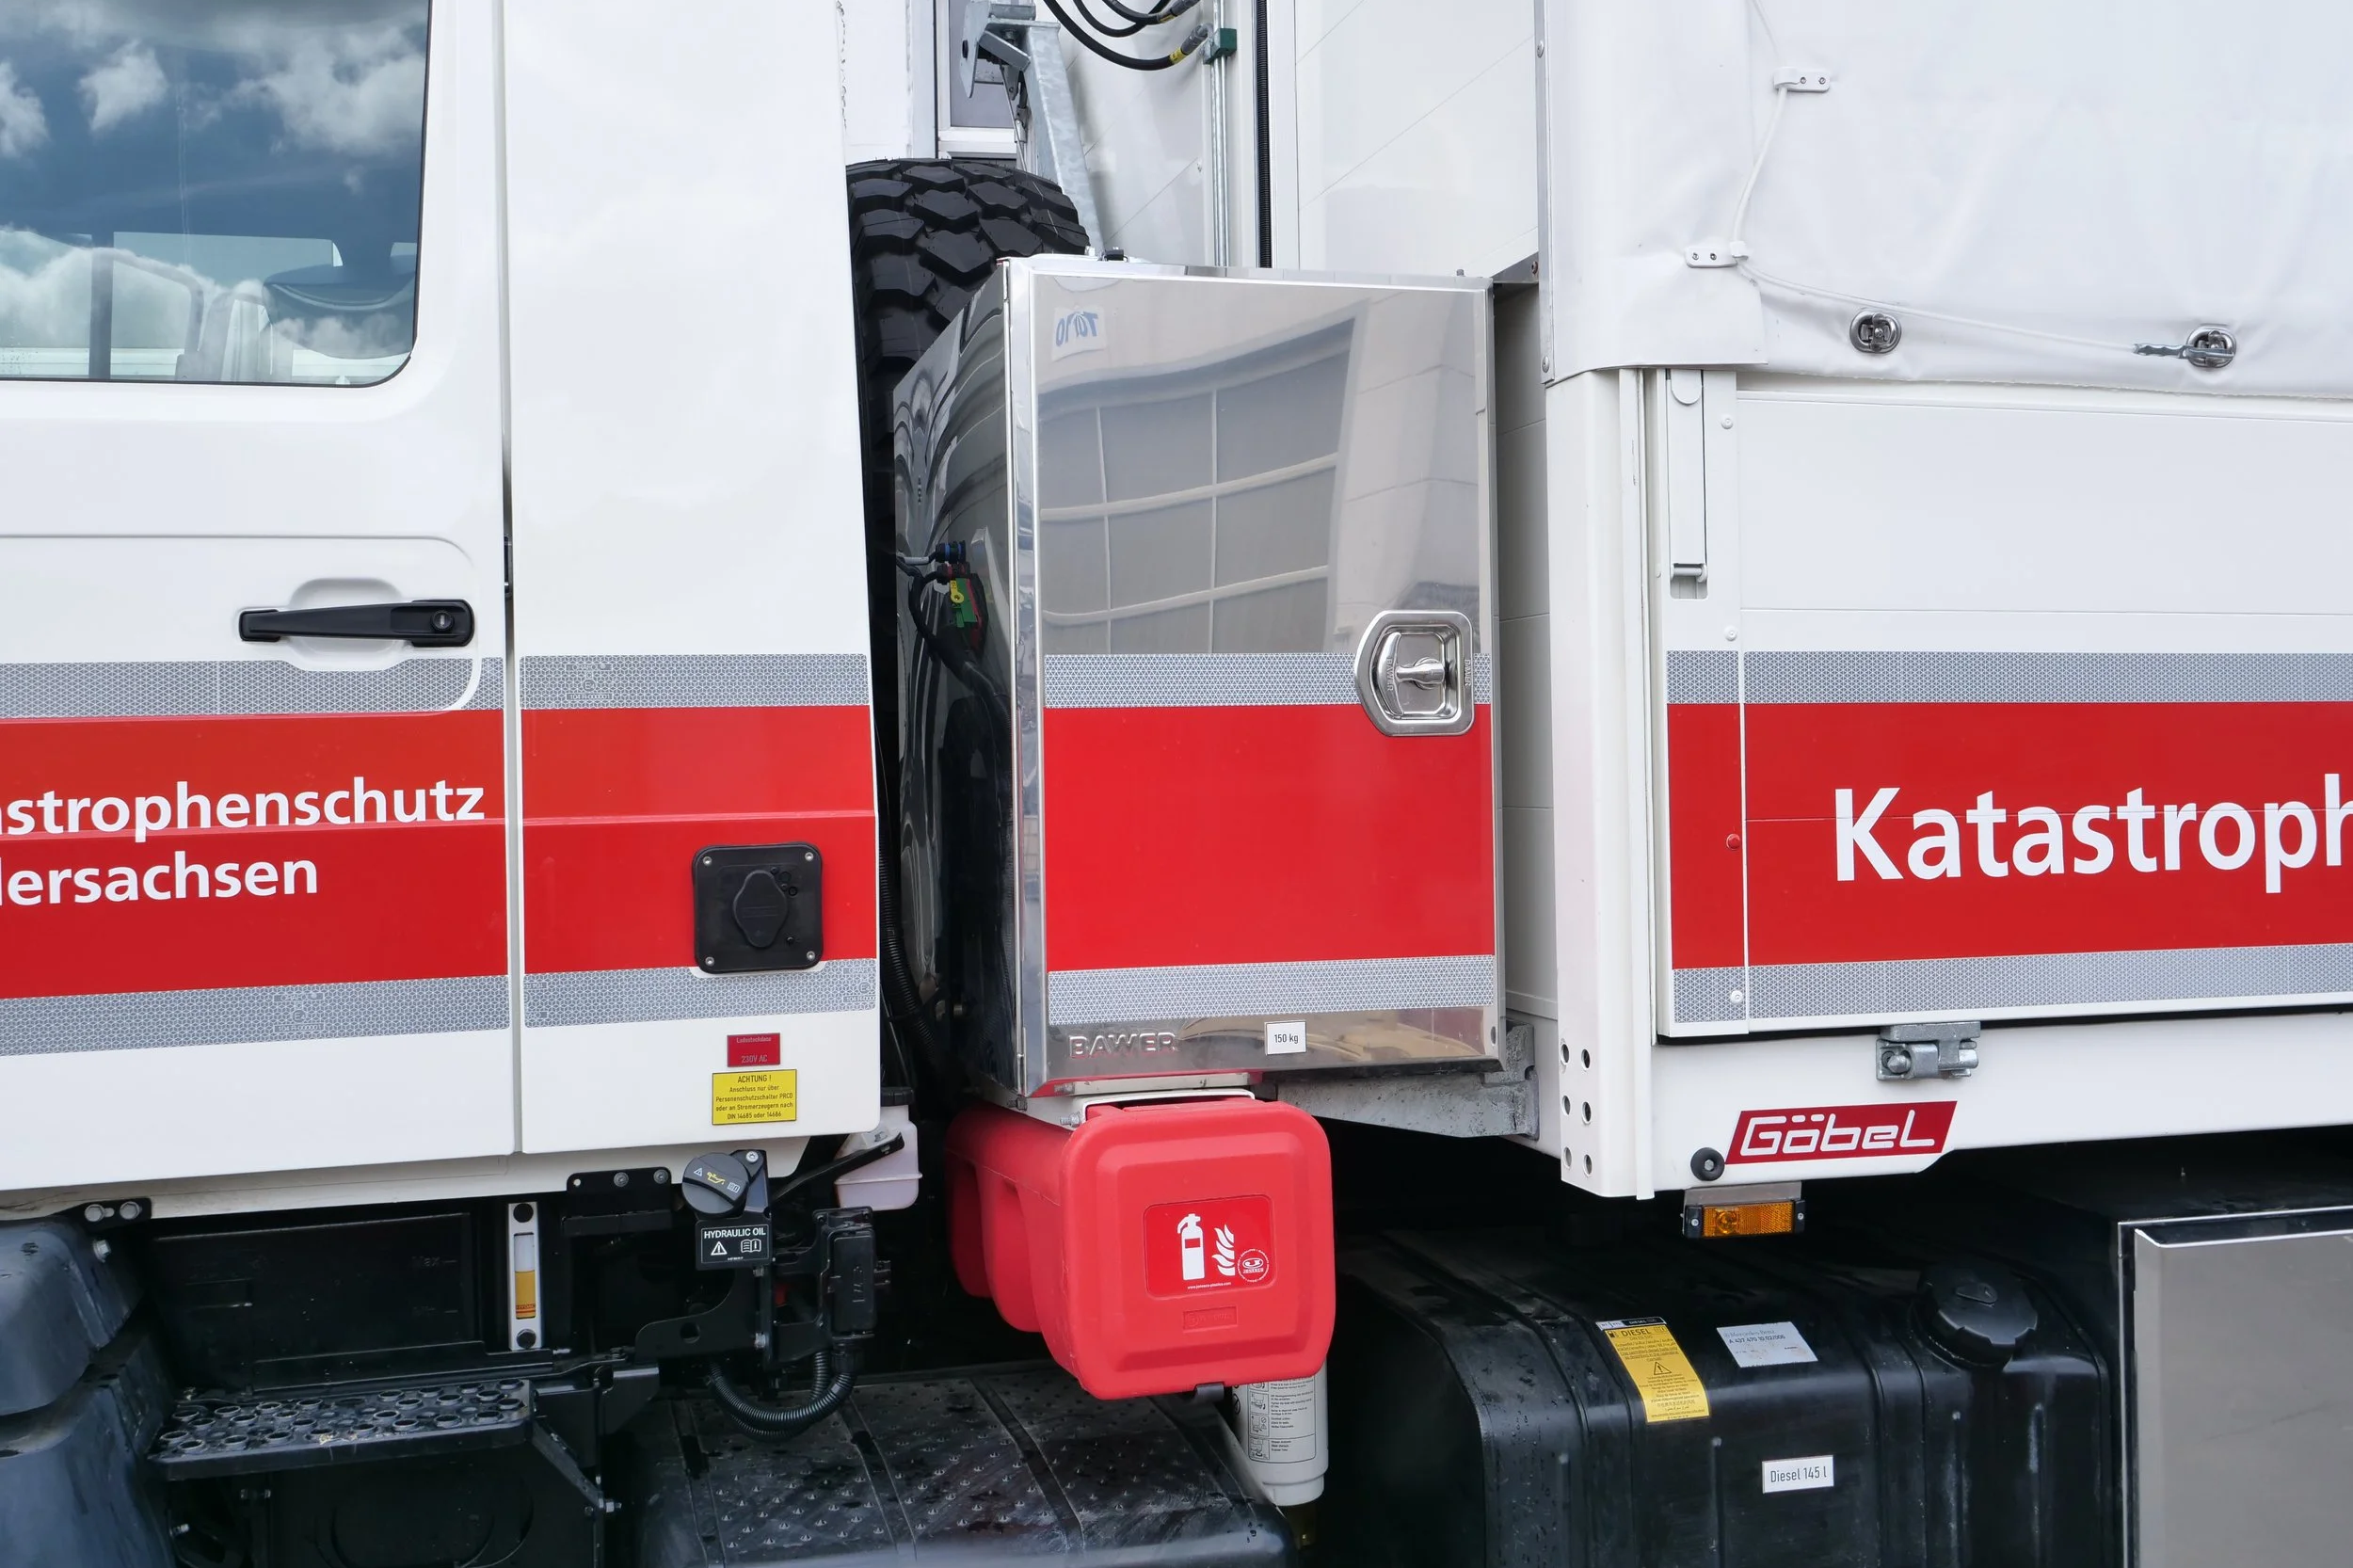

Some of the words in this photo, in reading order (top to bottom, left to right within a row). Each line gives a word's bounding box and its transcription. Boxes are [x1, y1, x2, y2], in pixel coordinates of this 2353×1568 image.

[0, 776, 485, 842] strophenschutz
[1835, 774, 2353, 893] Katastroph
[0, 851, 318, 906] ersachsen
[1273, 1033, 1288, 1044] 150
[1289, 1032, 1299, 1045] kg
[1069, 1032, 1176, 1058] BAWER
[741, 1054, 758, 1064] 230V
[759, 1054, 768, 1063] AC
[737, 1075, 768, 1083] ACHTUNG
[715, 1094, 778, 1102] Personenschutzschalter
[737, 1103, 779, 1112] Stromerzeugern
[704, 1228, 751, 1239] HYDRAULIC
[752, 1227, 766, 1236] OIL
[1621, 1328, 1652, 1337] DIESEL
[1770, 1468, 1801, 1483] Diesel
[1803, 1465, 1820, 1480] 145
